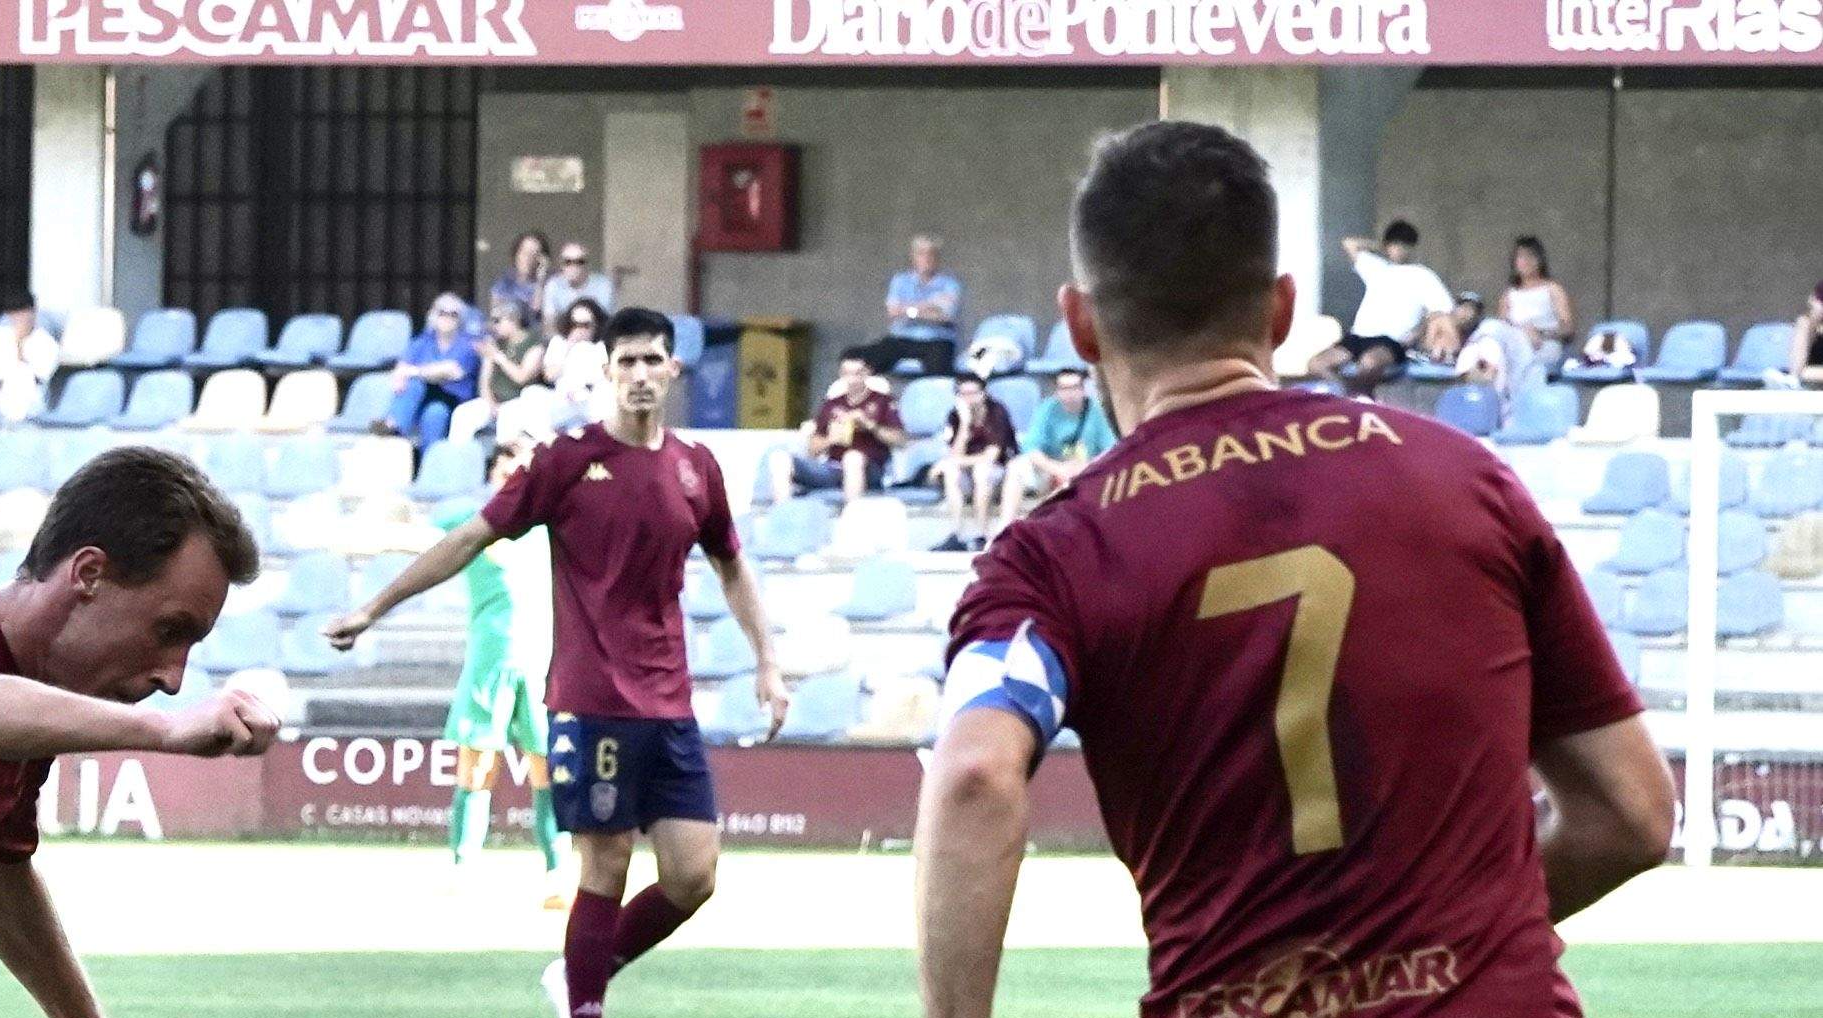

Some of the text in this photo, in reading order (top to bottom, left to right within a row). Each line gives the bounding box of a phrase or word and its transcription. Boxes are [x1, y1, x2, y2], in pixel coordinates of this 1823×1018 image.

[19, 0, 537, 56] PESCAMAR
[1196, 544, 1355, 855] 7
[596, 736, 619, 781] 6
